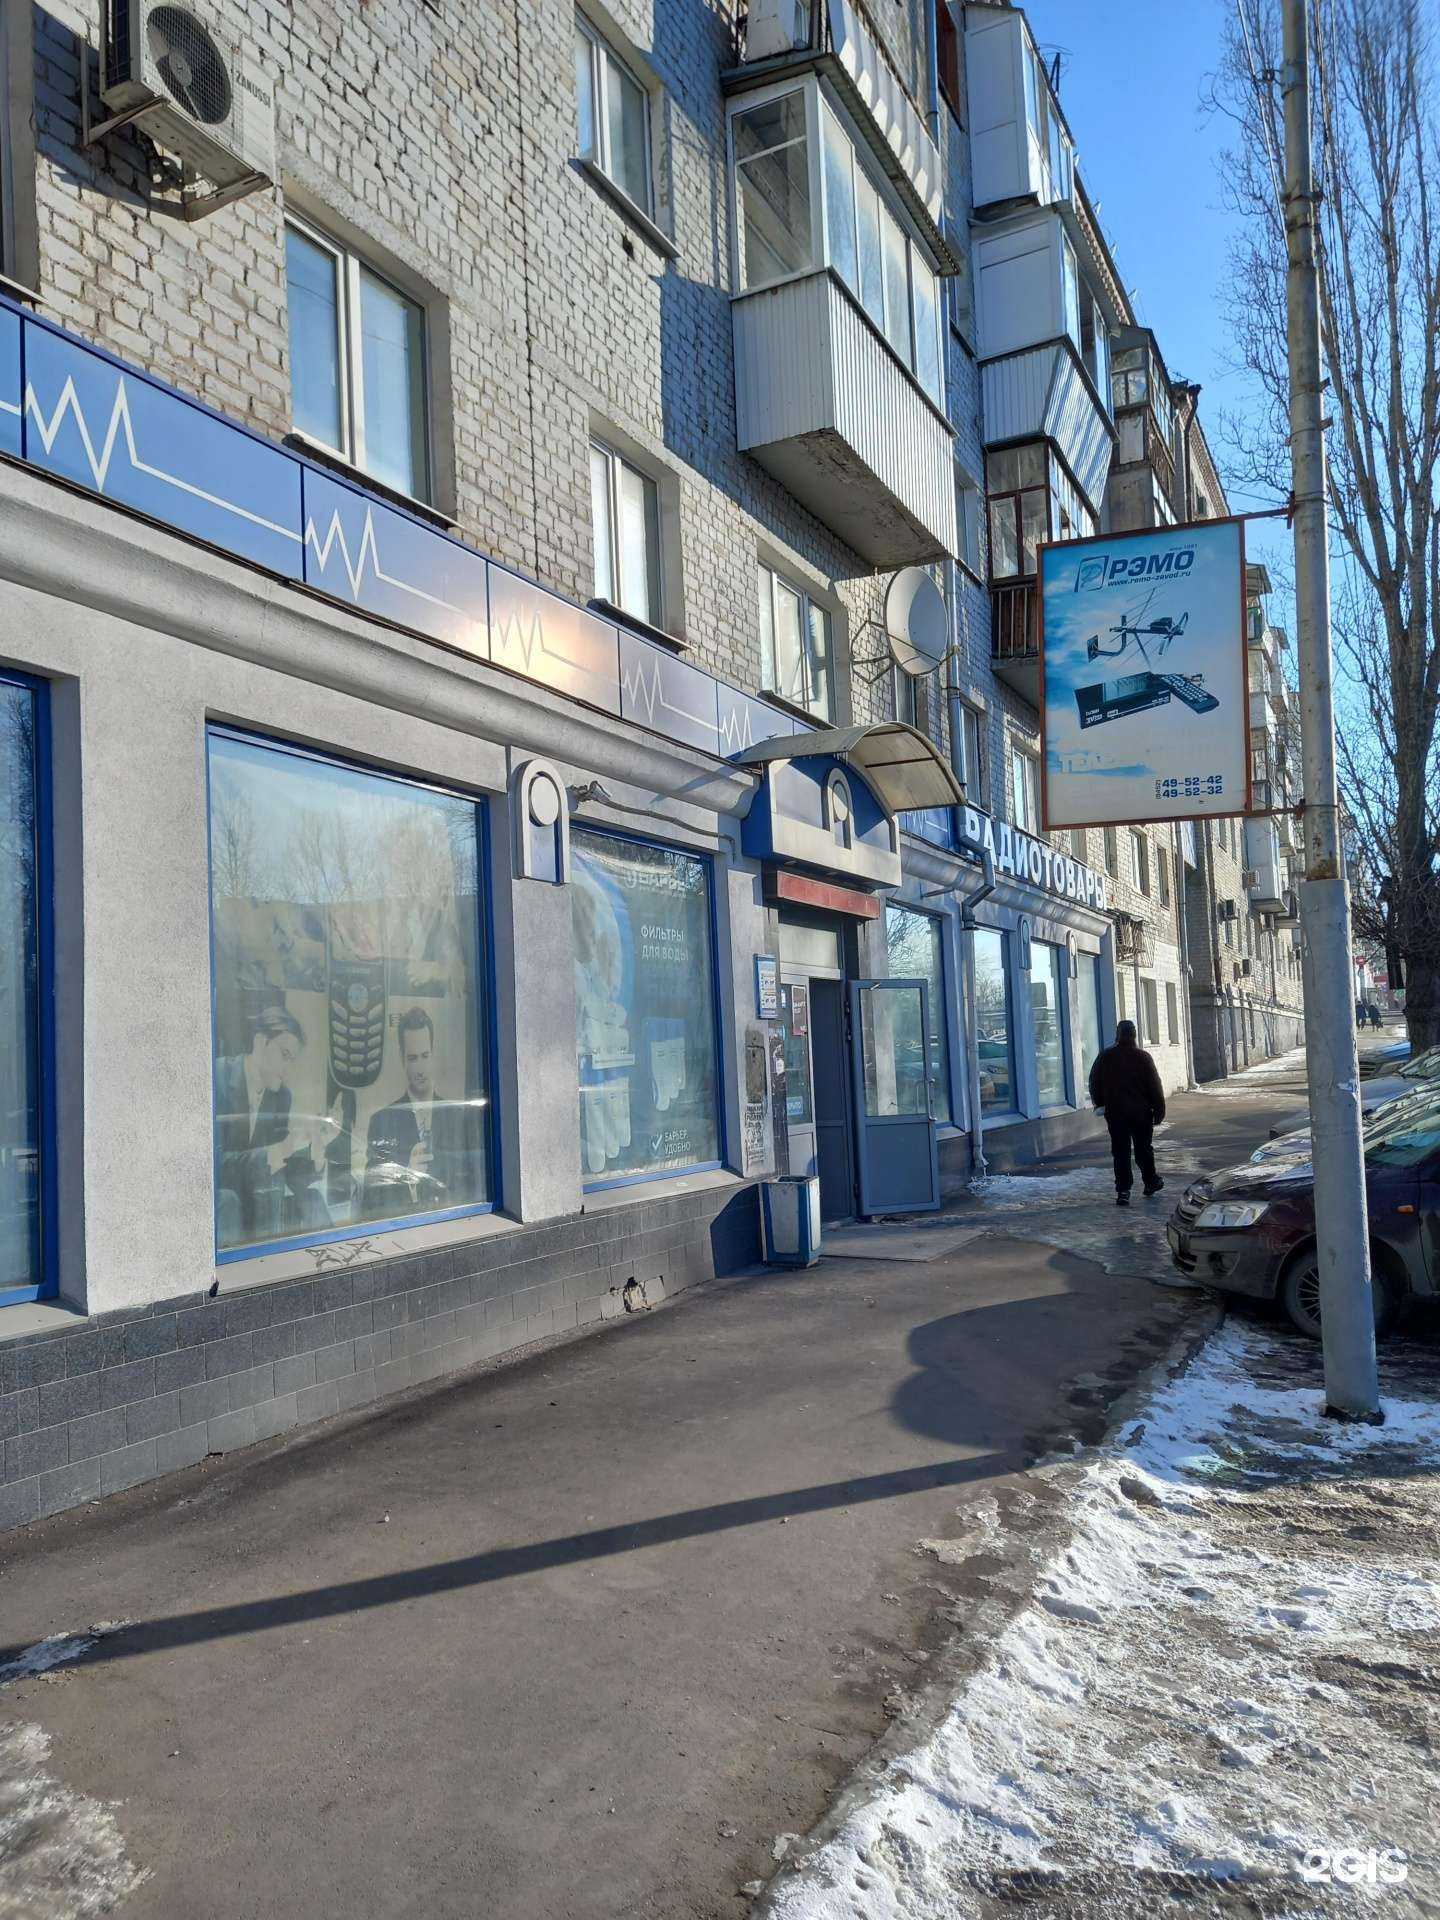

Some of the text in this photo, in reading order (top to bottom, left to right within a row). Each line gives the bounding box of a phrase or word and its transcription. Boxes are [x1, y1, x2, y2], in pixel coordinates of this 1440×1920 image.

[235, 70, 271, 109] ZANUSSI
[1109, 550, 1195, 580] РЭМО
[1107, 571, 1191, 587] www.remo-zavod.ru
[1162, 775, 1223, 788] 49-52-42
[1162, 785, 1223, 799] 49-52-32
[965, 806, 1107, 911] РАДИОТОВАРЫ
[641, 924, 684, 941] ФИЛЬТРЫ
[642, 944, 689, 961] ДЛЯ ВОДЫ
[664, 1141, 691, 1155] УДОБНО
